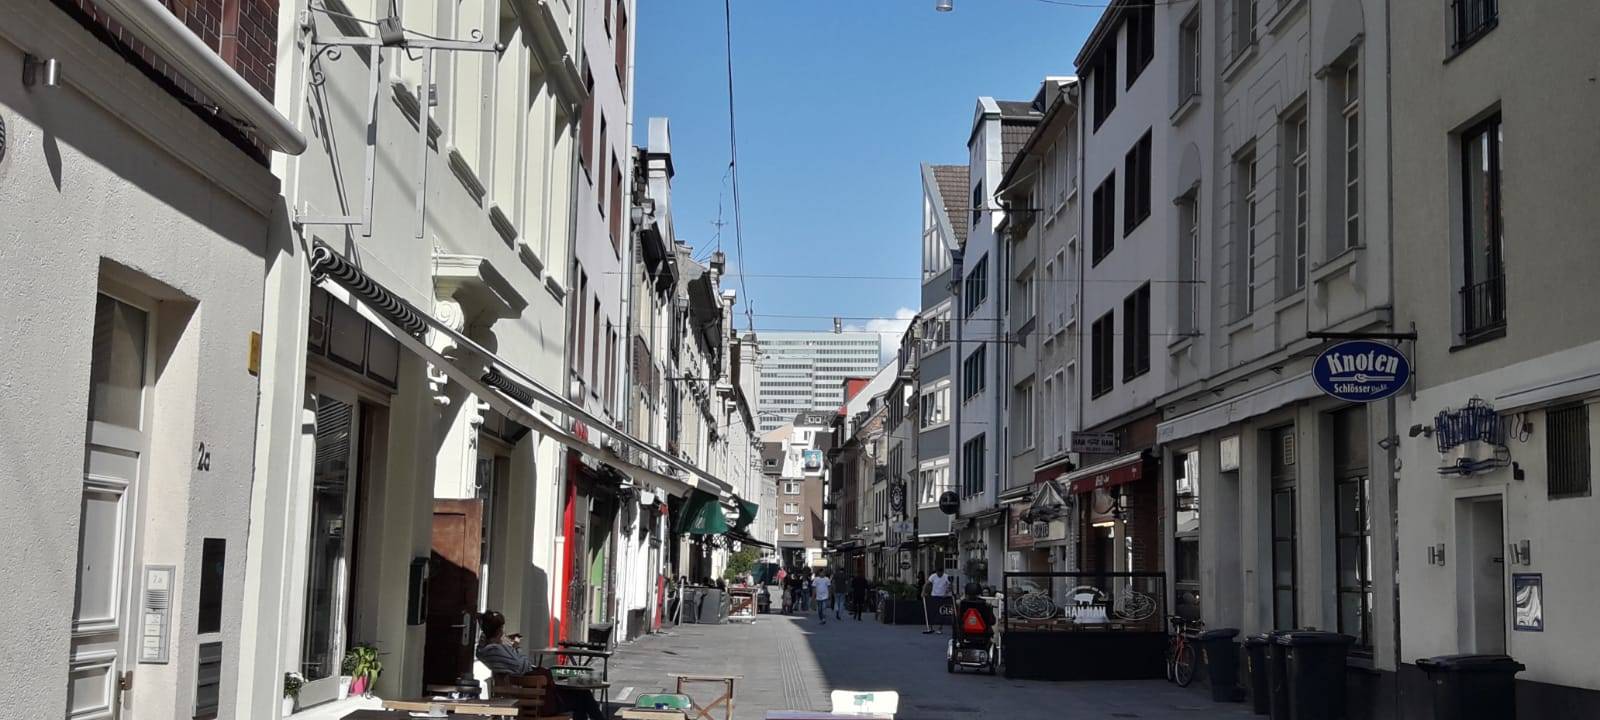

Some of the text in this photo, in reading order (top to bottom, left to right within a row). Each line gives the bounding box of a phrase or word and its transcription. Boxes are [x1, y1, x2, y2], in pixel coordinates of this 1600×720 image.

[1326, 350, 1399, 375] Knoten
[1334, 383, 1371, 393] Schlösser
[197, 441, 211, 472] 2a
[1064, 605, 1084, 618] HAM
